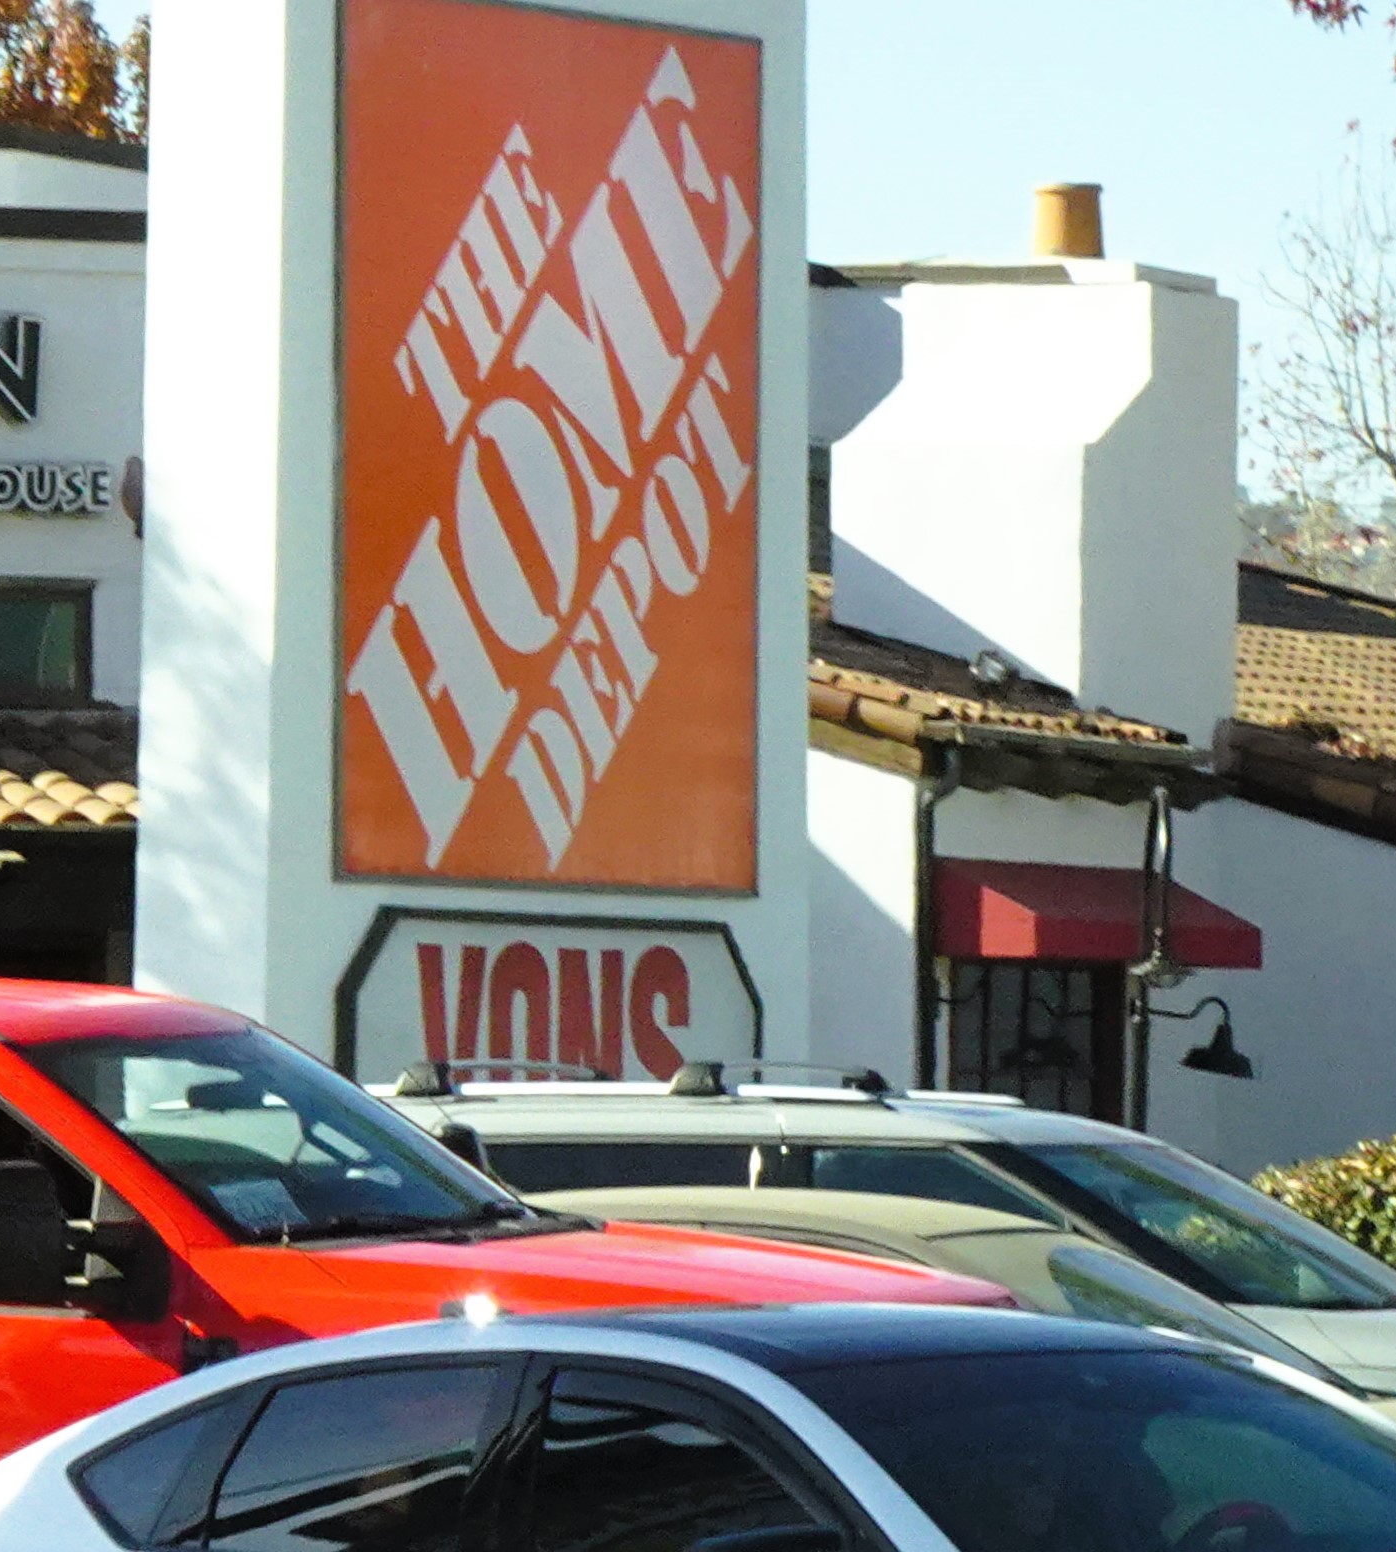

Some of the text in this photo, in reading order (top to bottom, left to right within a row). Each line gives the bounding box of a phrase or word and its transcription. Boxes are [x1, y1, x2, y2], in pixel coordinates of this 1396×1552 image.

[346, 44, 754, 870] HOME
[393, 123, 564, 445] THE
[504, 352, 753, 873] DEPOT
[415, 939, 691, 1082] VONS
